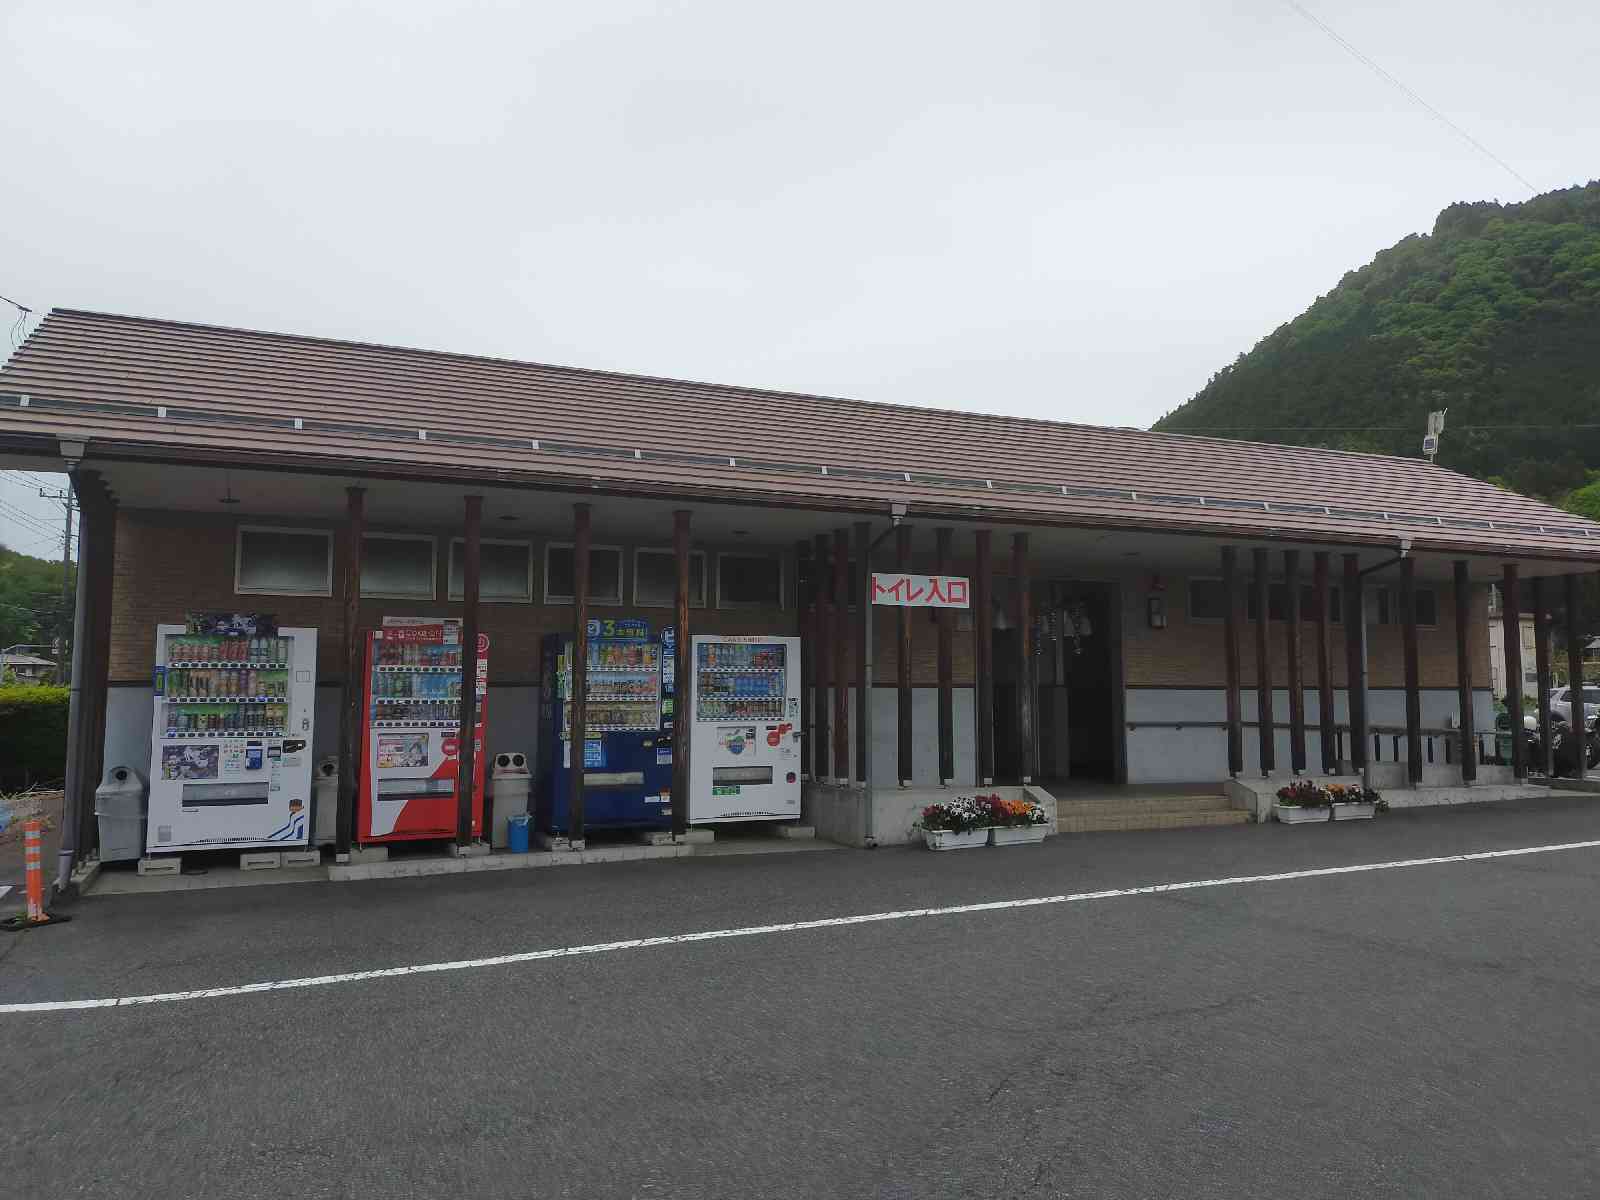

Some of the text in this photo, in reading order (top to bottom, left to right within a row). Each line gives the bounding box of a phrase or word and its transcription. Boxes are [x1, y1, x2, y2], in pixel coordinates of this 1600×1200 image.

[872, 576, 967, 603] トイレ入口
